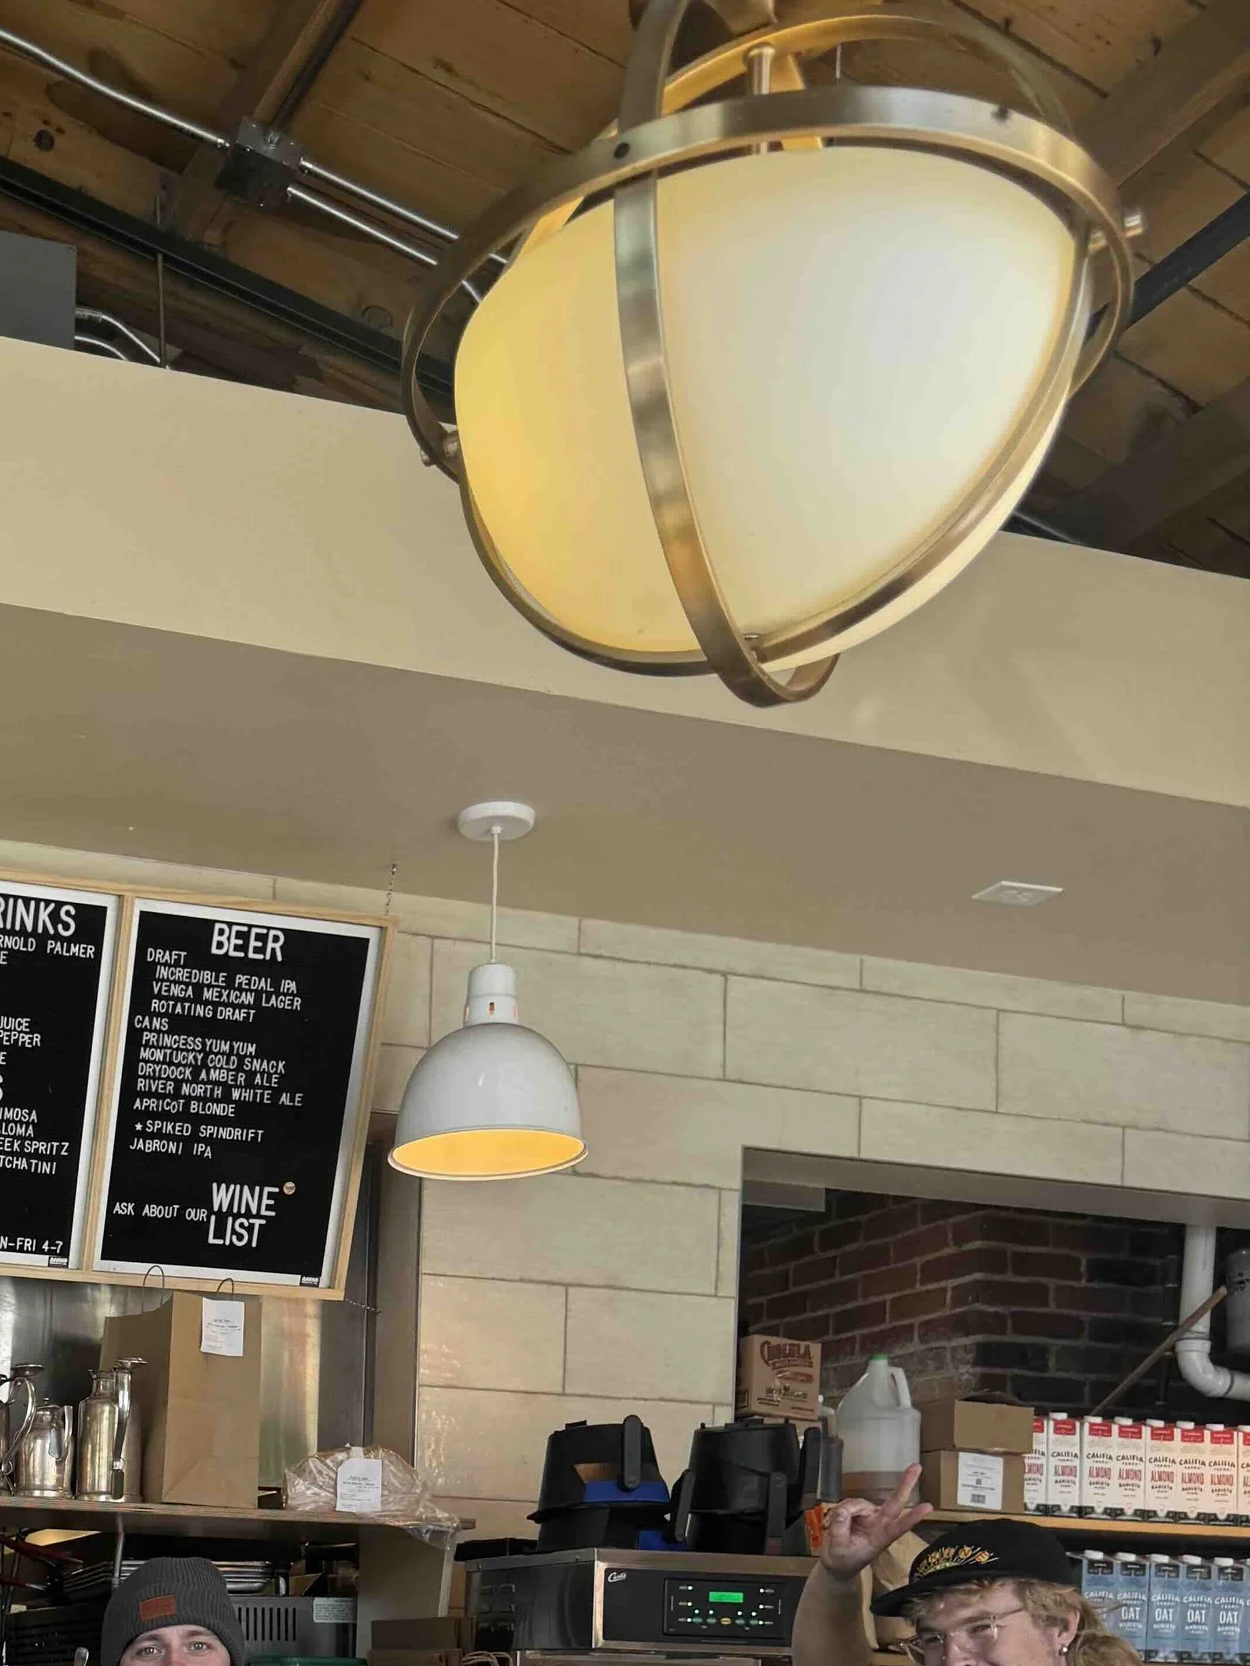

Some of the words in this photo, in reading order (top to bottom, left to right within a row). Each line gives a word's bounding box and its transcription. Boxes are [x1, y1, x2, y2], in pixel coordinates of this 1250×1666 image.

[47, 940, 94, 958] PALMER
[211, 923, 284, 961] BEER
[148, 948, 186, 964] DRAFT
[156, 966, 227, 986] INCREDIBLE
[235, 975, 274, 991] PEDAL
[280, 980, 296, 993] IPA
[153, 981, 193, 998] VENGA
[203, 988, 254, 1004] MEXICAN
[262, 994, 301, 1010] LAGER
[151, 1000, 212, 1017] ROTATING
[217, 1007, 255, 1022] DRAFT
[135, 1016, 168, 1030] CANS
[142, 1032, 202, 1050] PRINCESS
[206, 1039, 230, 1053] YUM
[233, 1042, 256, 1055] YUM
[140, 1047, 203, 1065] MONTUCKY
[208, 1055, 237, 1068] COLD
[244, 1058, 285, 1074] SNACK
[138, 1078, 174, 1094] RIVER
[182, 1083, 222, 1098] NORTH
[232, 1088, 271, 1103] WHITE
[280, 1093, 302, 1105] ALE
[134, 1098, 184, 1113] APRICOT
[190, 1101, 235, 1116] BLONDE
[146, 1120, 191, 1135] SPIKED
[199, 1126, 263, 1142] SPINDRIFT
[24, 1141, 69, 1155] SPRITZ
[130, 1138, 182, 1154] JABRONI
[194, 1144, 211, 1158] IPA
[213, 1183, 279, 1216] WINE
[208, 1215, 266, 1247] LIST
[1054, 1465, 1077, 1477] ALMOND
[1089, 1467, 1111, 1479] ALMOND
[1118, 1468, 1142, 1481] ALMOND
[1151, 1470, 1174, 1483] ALMOND
[1181, 1472, 1204, 1485] ALMOND
[1121, 1607, 1140, 1620] OAT
[1155, 1608, 1173, 1621] OAT
[1187, 1610, 1206, 1623] OAT
[1219, 1611, 1238, 1624] OAT
